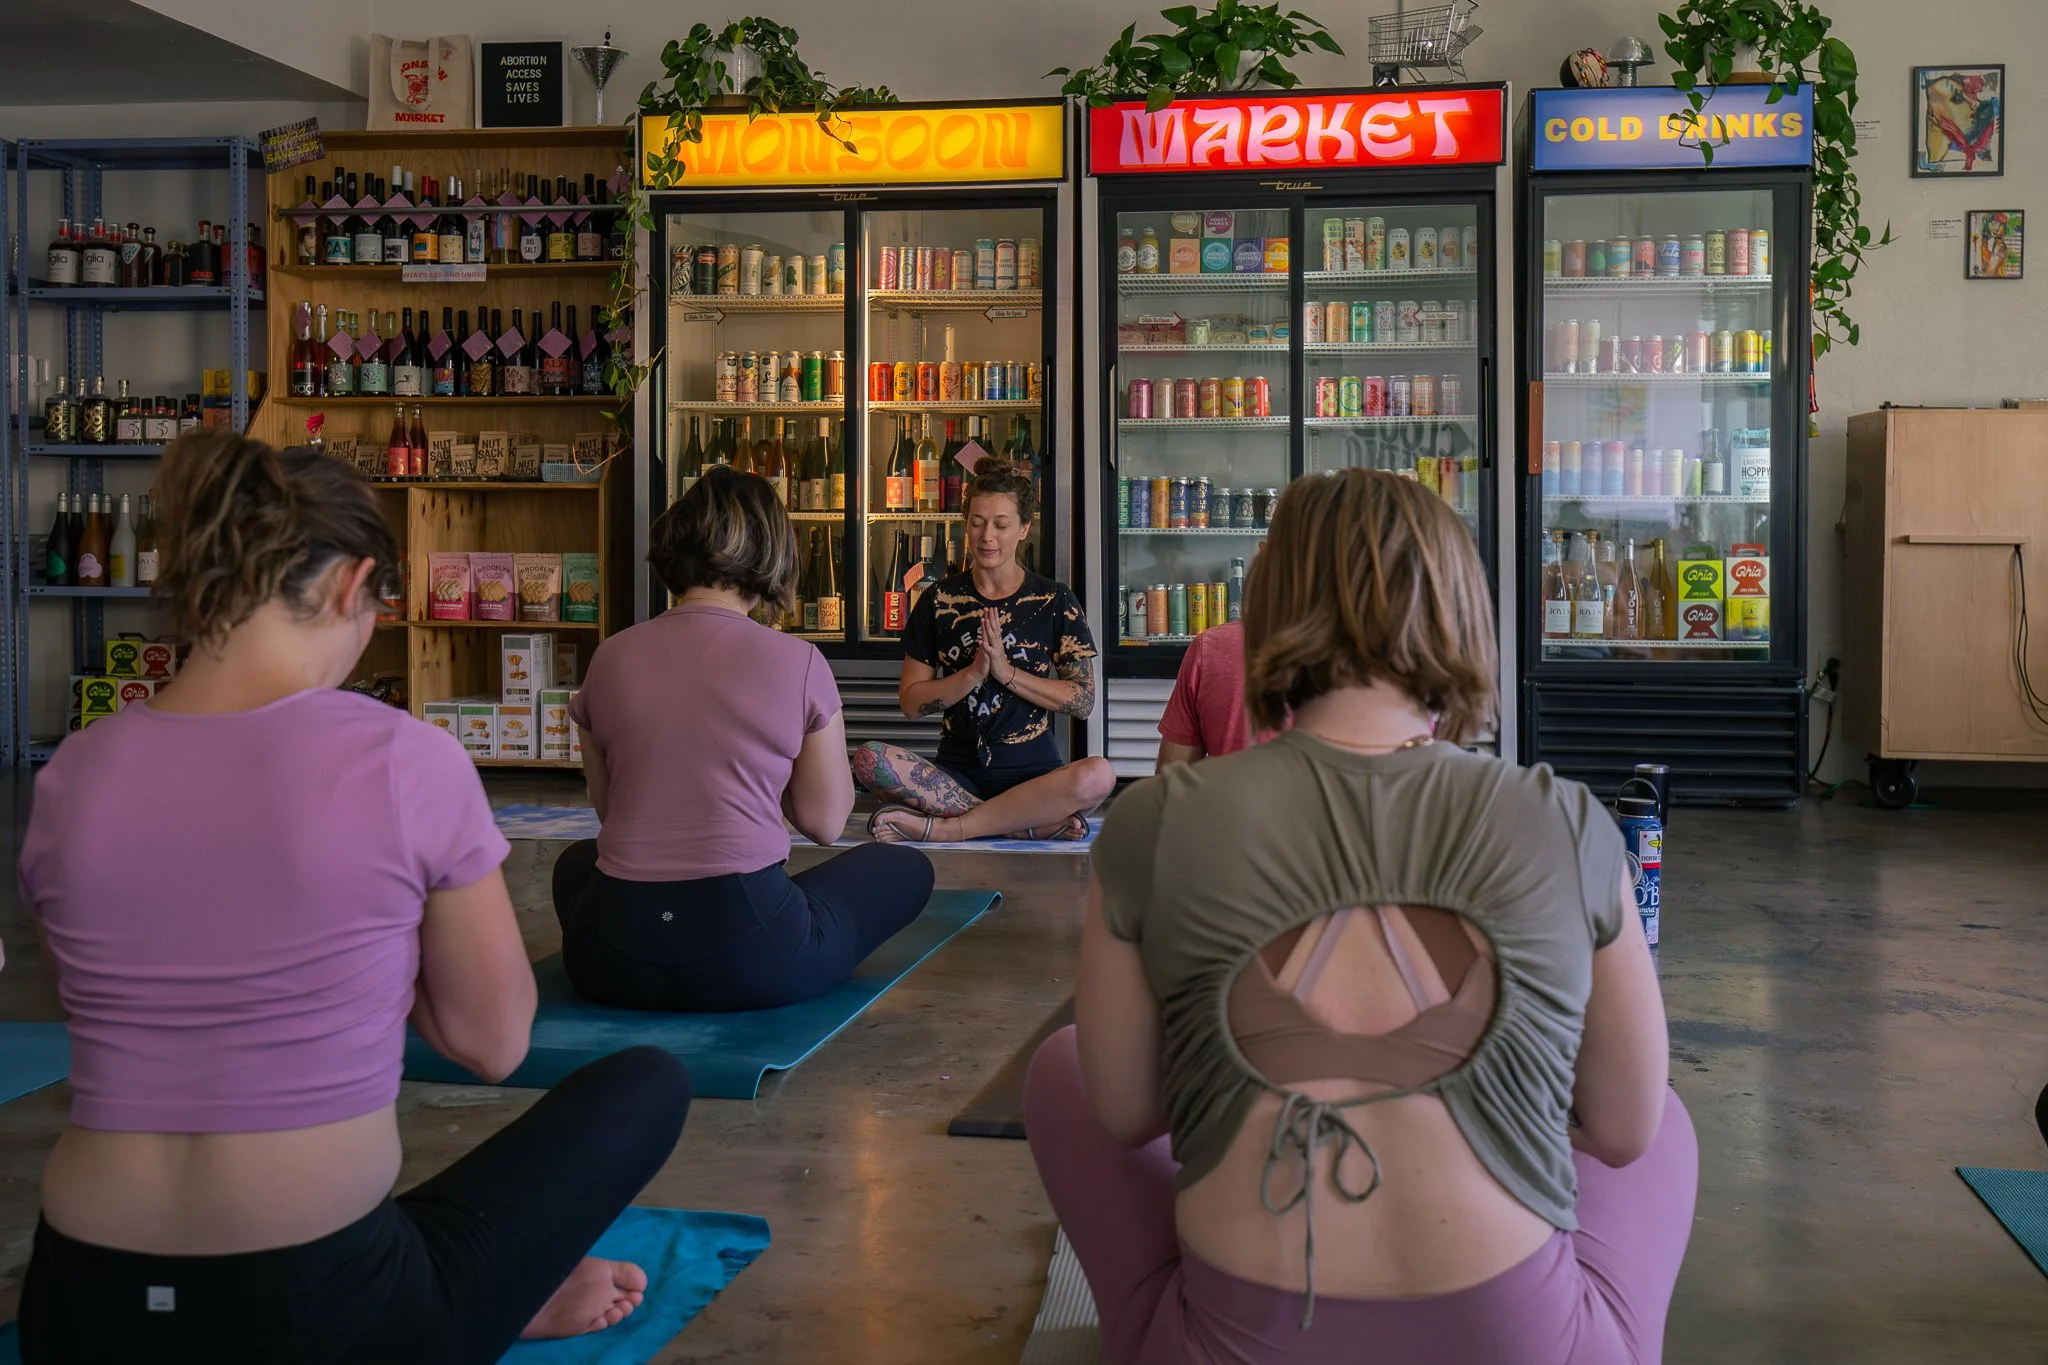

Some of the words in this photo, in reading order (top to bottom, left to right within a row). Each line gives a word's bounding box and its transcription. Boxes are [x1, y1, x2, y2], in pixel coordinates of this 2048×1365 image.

[500, 55, 547, 66] ABORTION
[505, 69, 542, 79] ACCESS
[505, 82, 540, 92] SAVES
[507, 94, 540, 103] LIVES
[395, 112, 446, 123] MARKET
[1118, 97, 1472, 167] MARKET
[1544, 116, 1643, 142] COLD
[1658, 112, 1804, 140] DRINKS
[682, 112, 1031, 176] MONSOON
[267, 148, 295, 163] SAVE
[333, 441, 350, 450] NUT
[433, 439, 453, 450] NUT
[482, 438, 501, 449] NUT
[579, 439, 598, 449] NUT
[430, 449, 452, 461] SAC
[478, 448, 504, 459] SACK
[455, 459, 473, 467] NUT
[519, 460, 534, 468] NUT
[515, 467, 537, 476] SACK
[1119, 485, 1129, 525] Courtside
[1131, 485, 1141, 525] Courtside
[435, 565, 468, 573] BROOKLYN
[477, 565, 511, 573] BROOKLYN
[520, 565, 555, 574] BROOKLYN
[568, 565, 599, 574] BROOKLYN
[1735, 565, 1762, 577] Ghia
[1687, 569, 1713, 581] Ghia
[1628, 590, 1636, 625] TOST
[1653, 590, 1661, 625] TOST
[1687, 609, 1713, 621] Ghia
[113, 648, 134, 660] Ghia
[146, 647, 167, 662] Ghia
[89, 685, 111, 698] Ghia
[124, 685, 146, 698] Ghia
